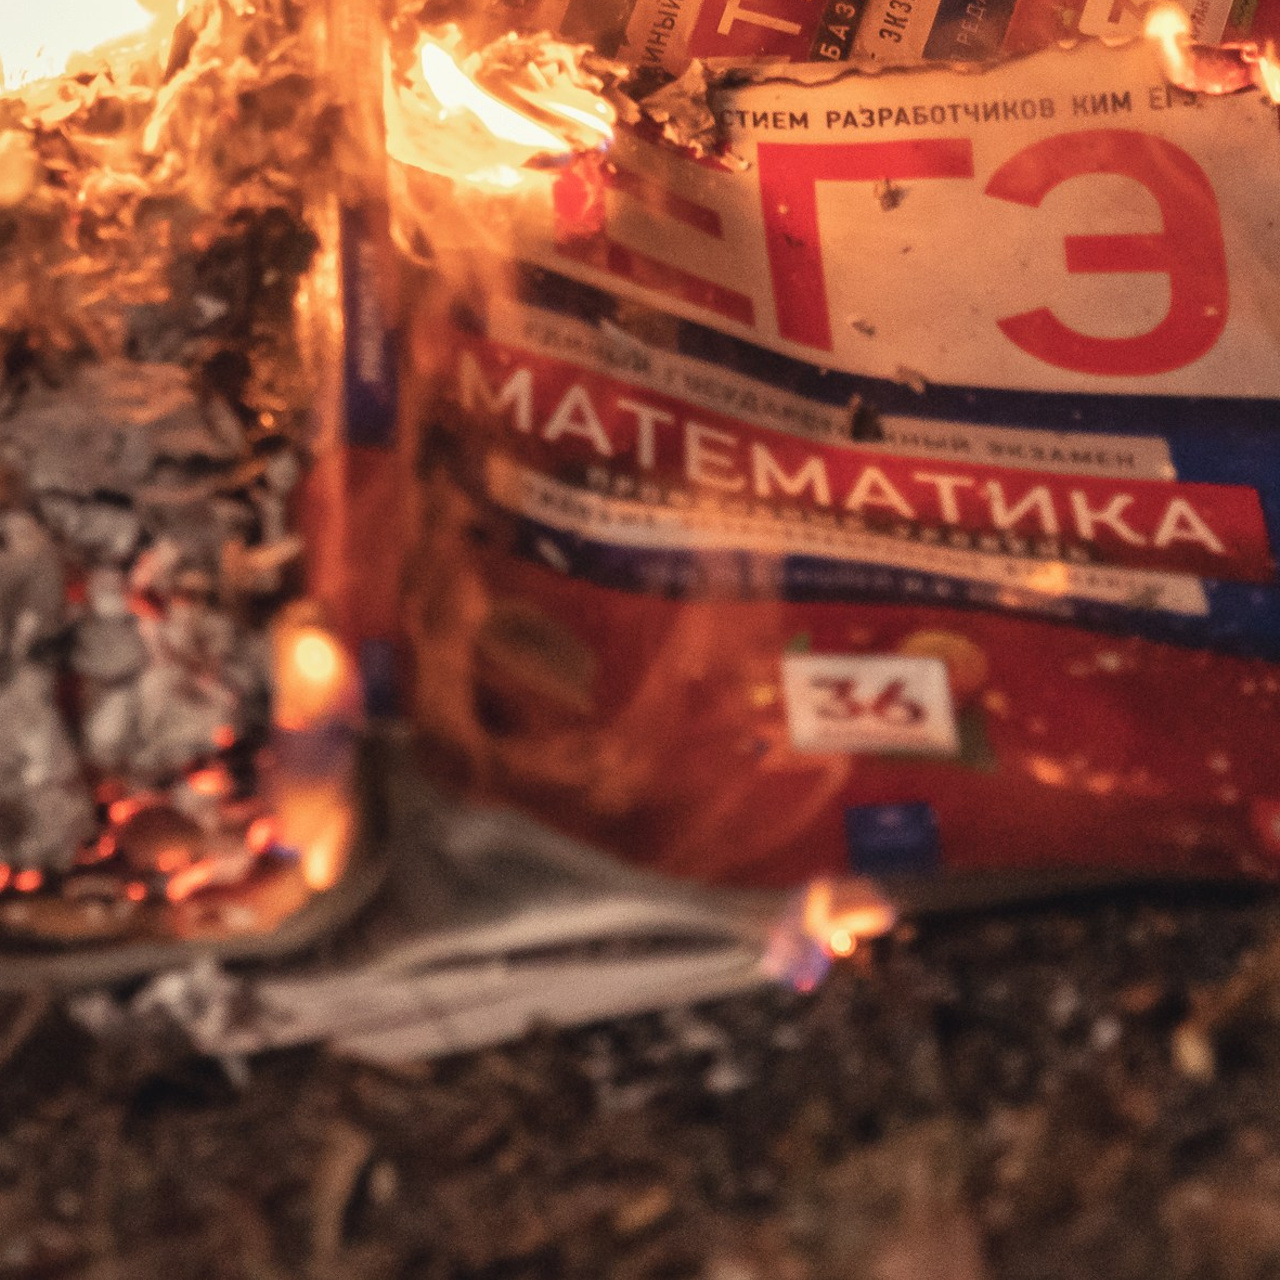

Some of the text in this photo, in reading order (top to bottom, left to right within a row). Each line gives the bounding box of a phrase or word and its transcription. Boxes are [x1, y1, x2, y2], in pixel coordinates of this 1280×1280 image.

[825, 97, 1056, 130] РАЗРАБОТЧИКОВ
[1072, 90, 1133, 118] КИМ
[456, 348, 1226, 554] МАТЕМАТИКА
[810, 675, 927, 723] 36
